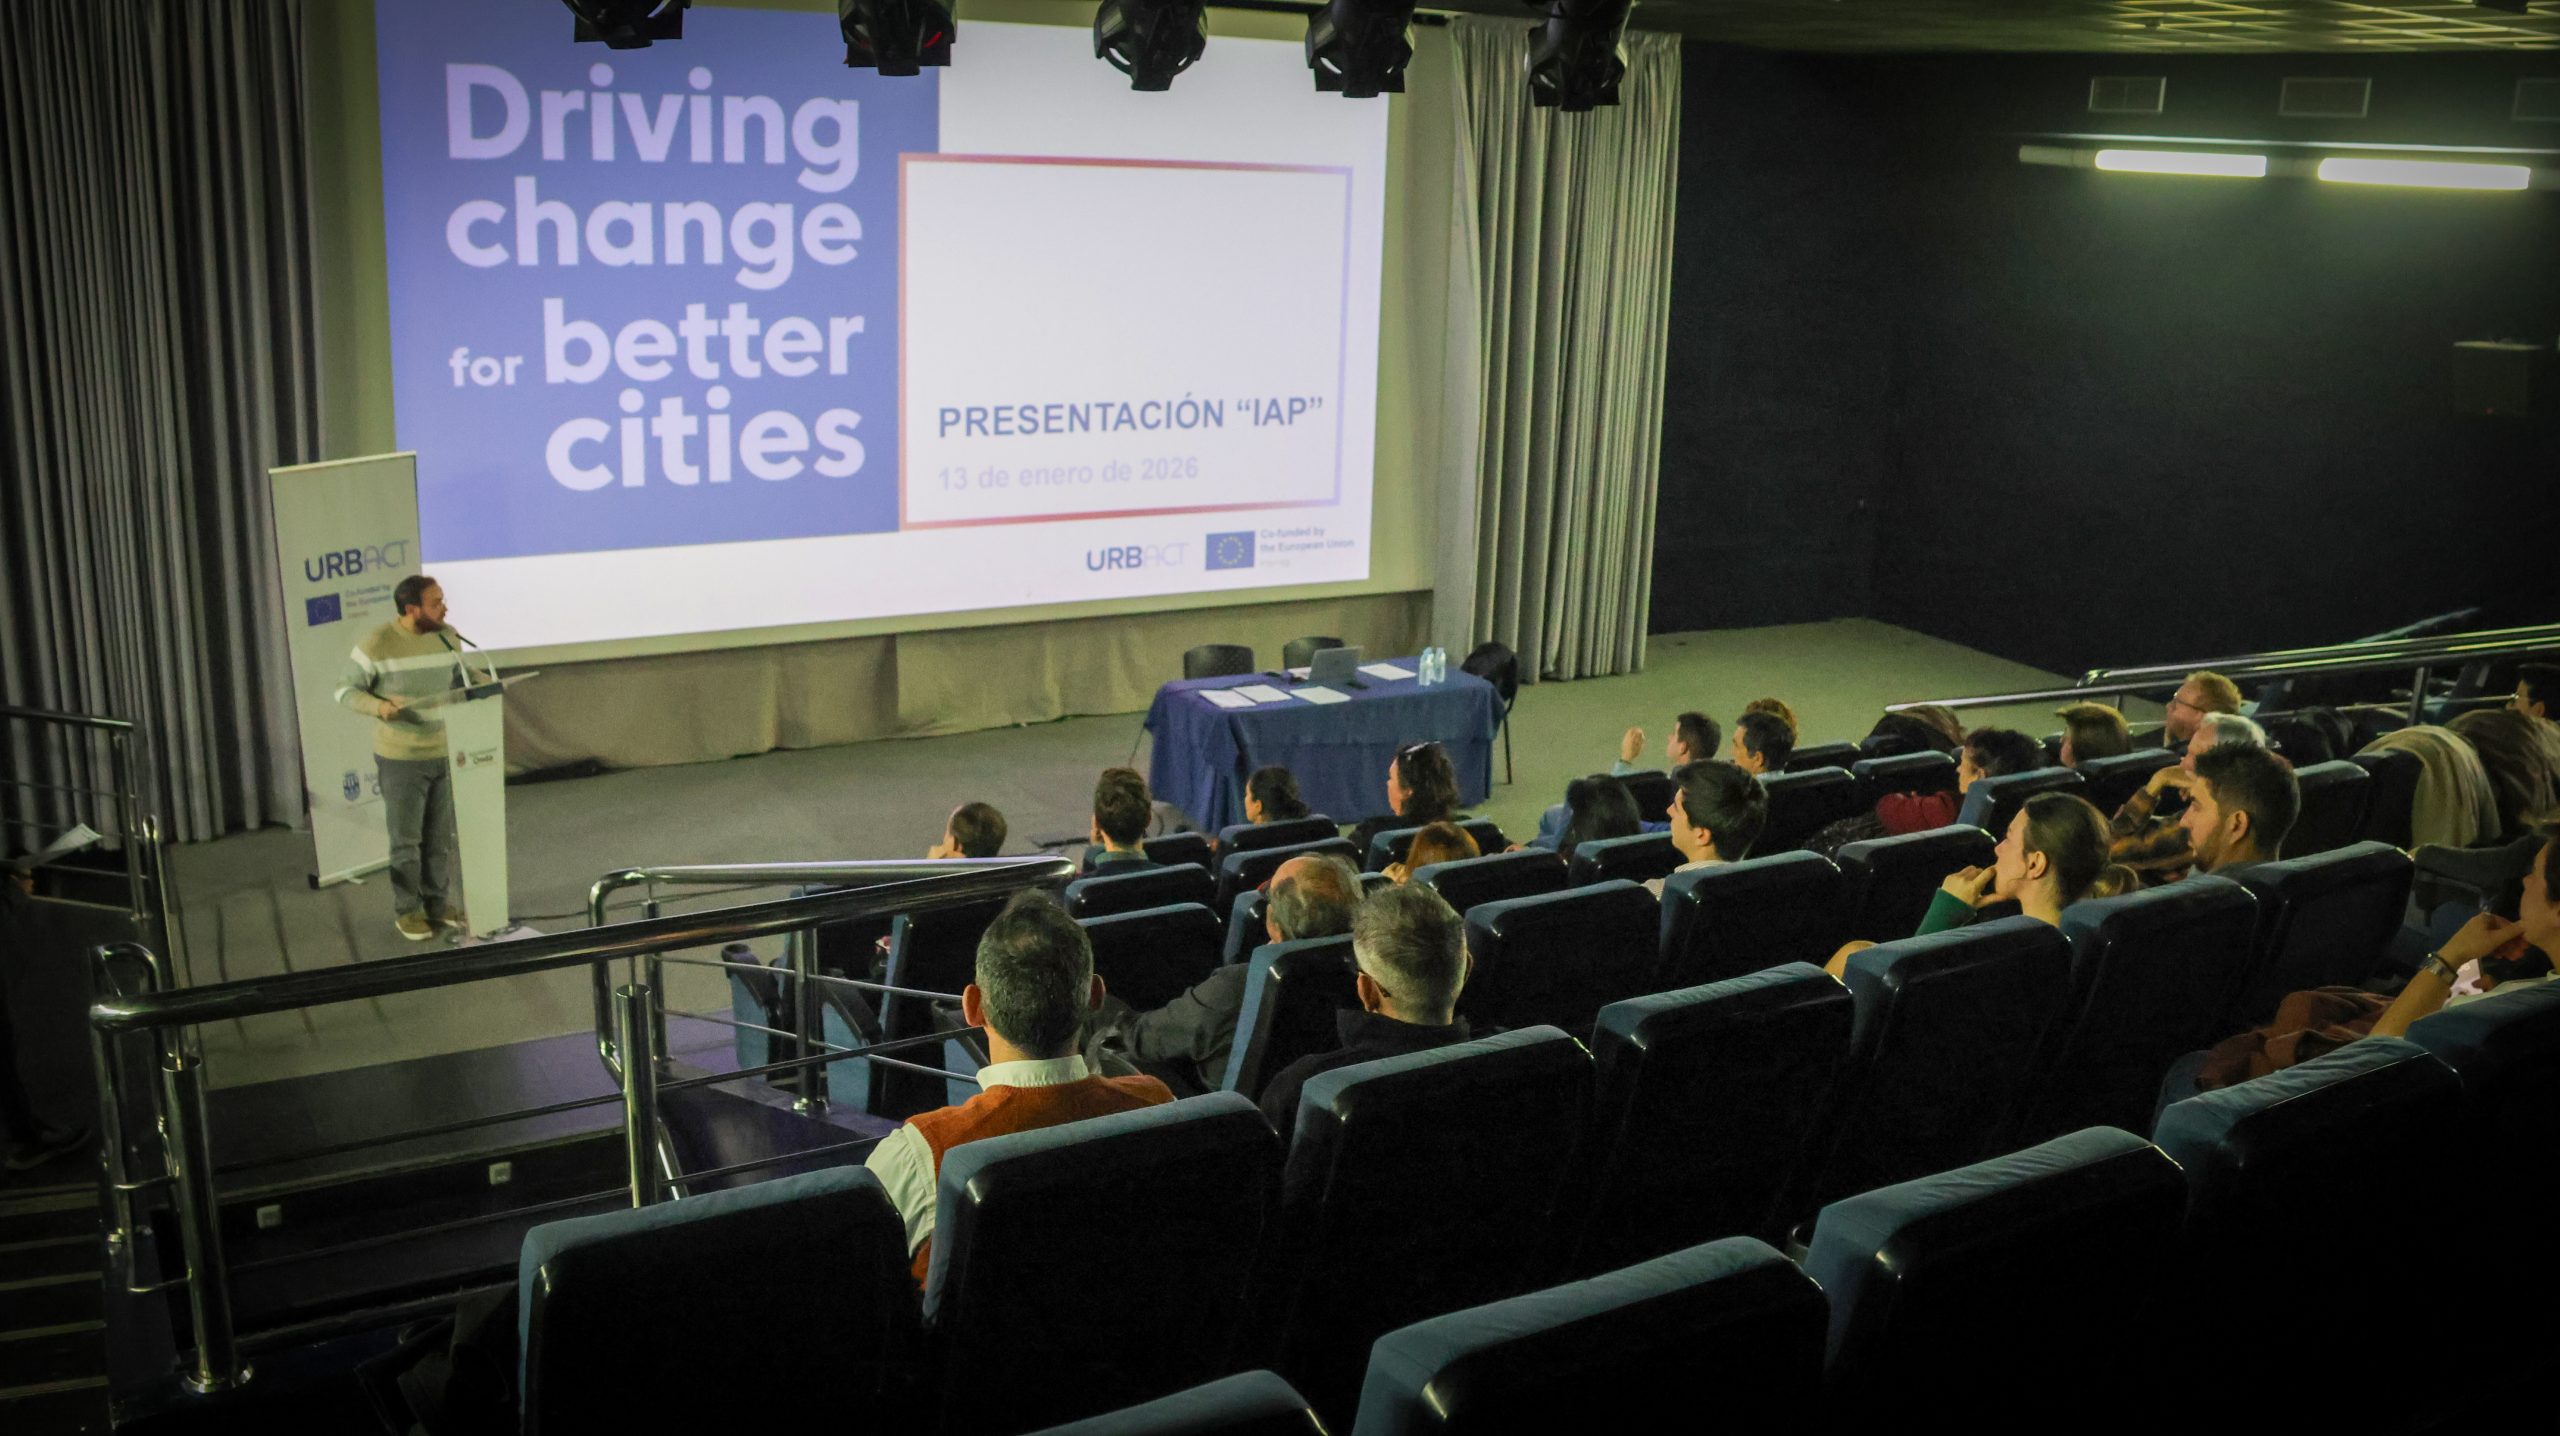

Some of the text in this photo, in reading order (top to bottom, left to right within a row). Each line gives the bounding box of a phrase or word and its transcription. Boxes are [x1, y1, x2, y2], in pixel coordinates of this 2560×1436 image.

[446, 62, 860, 193] Driving
[446, 176, 863, 291] change
[450, 298, 865, 387] for better
[545, 386, 866, 491] cities
[938, 393, 1225, 438] PRESENTACIÓN
[938, 455, 1199, 491] 13 de enero de 2026
[304, 539, 410, 582] URBACT
[1086, 542, 1189, 571] URBACT
